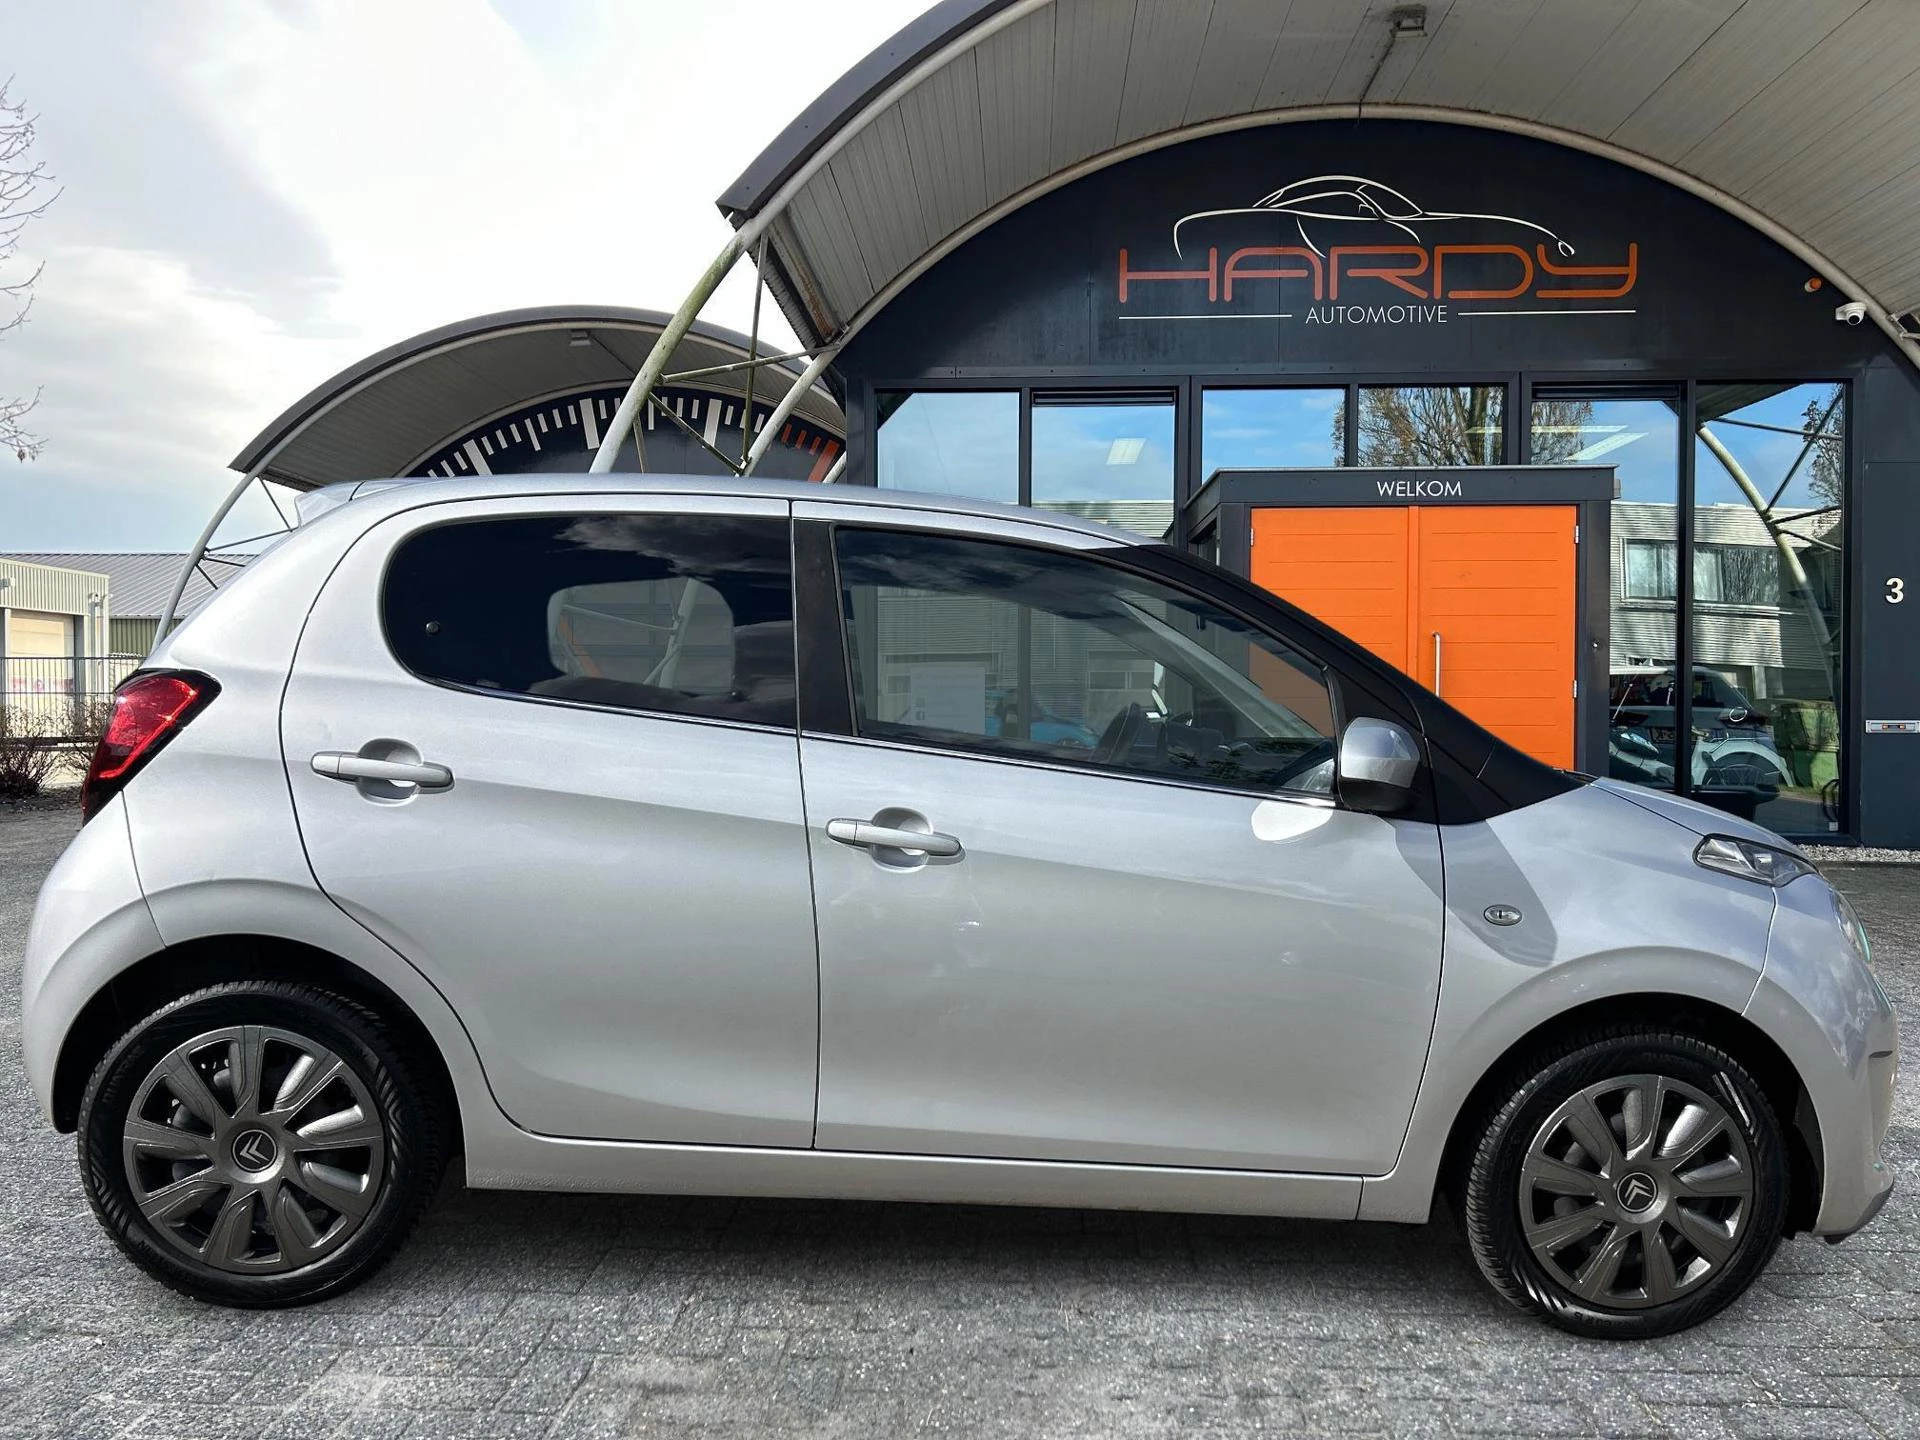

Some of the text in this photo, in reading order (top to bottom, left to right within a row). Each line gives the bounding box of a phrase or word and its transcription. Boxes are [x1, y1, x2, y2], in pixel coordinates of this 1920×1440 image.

[1118, 242, 1639, 303] HARDY
[1305, 305, 1448, 325] AUTOMOTIVE
[1376, 480, 1462, 497] WELKOM
[1885, 577, 1904, 604] 3
